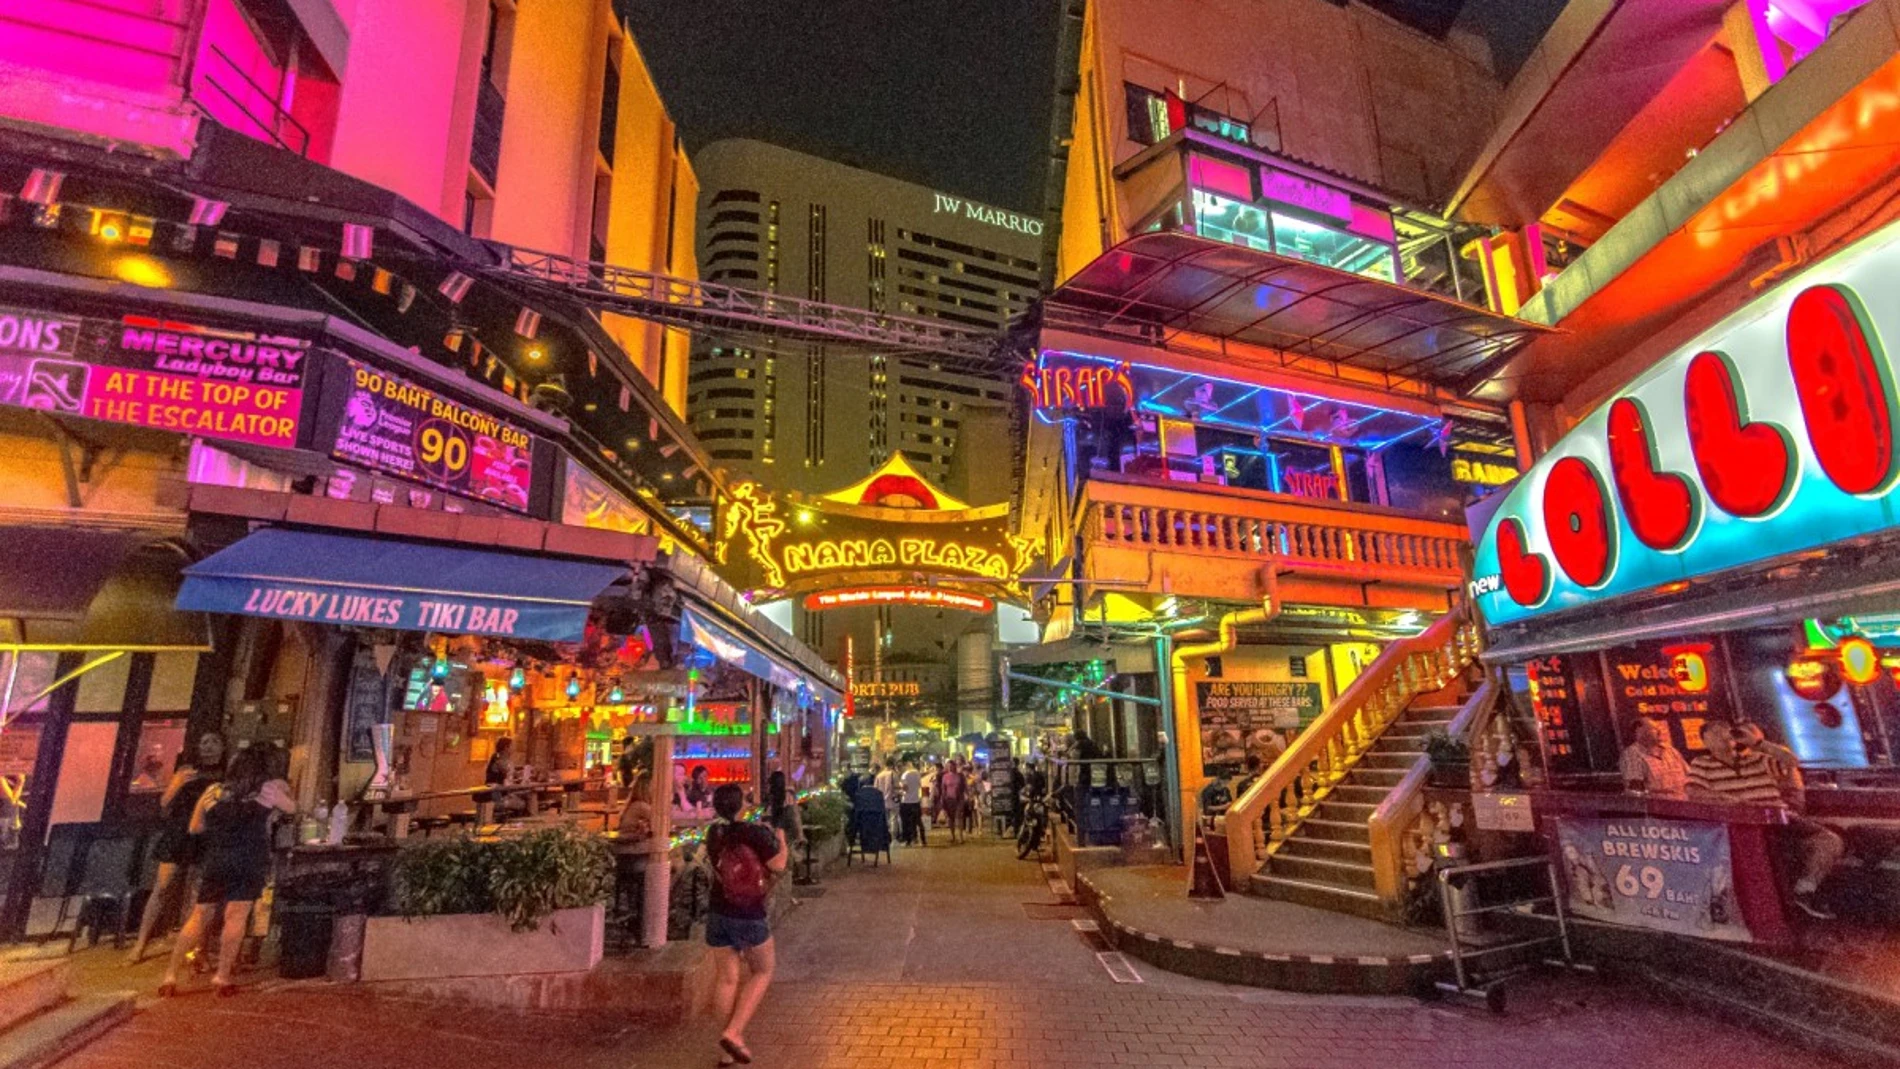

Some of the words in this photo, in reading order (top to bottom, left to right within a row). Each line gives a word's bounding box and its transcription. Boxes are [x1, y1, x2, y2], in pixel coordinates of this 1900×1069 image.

[933, 193, 961, 213] JW
[965, 202, 1044, 236] MARRIO
[0, 314, 62, 352] ONS
[122, 327, 305, 370] MERCURY
[155, 354, 254, 383] Ladyboy
[258, 367, 300, 384] Bar
[106, 372, 140, 394] AT
[147, 375, 195, 401] THE
[201, 382, 249, 405] TOP
[255, 389, 288, 410] OF
[1020, 361, 1134, 410] STRAPS
[93, 397, 142, 423] THE
[150, 404, 296, 439] ESCALATOR
[355, 369, 382, 392] 90
[384, 380, 431, 411] BAHT
[432, 399, 501, 438] BALCONY
[501, 426, 529, 450] BAR
[335, 438, 380, 461] SHOWN
[341, 425, 368, 443] LIVE
[369, 434, 413, 456] SPORTS
[421, 428, 467, 471] 90
[784, 539, 896, 573] NANA
[900, 539, 1009, 579] PLAZA
[1468, 574, 1500, 599] new
[244, 588, 328, 618] LUCKY
[326, 594, 405, 625] LUKES
[417, 601, 466, 630] TIKI
[466, 605, 519, 633] BAR
[1617, 662, 1679, 681] Welco
[889, 682, 919, 696] PUB
[1206, 696, 1229, 709] FOOD
[1229, 696, 1258, 709] SERVED
[1269, 695, 1291, 708] THESE
[1210, 683, 1231, 697] ARE
[1232, 683, 1254, 697] YOU
[1254, 683, 1294, 697] HUNGRY
[1606, 824, 1638, 838] ALL
[1640, 826, 1690, 842] LOCAL
[1602, 839, 1701, 865] BREWSKIS
[1615, 864, 1665, 899] 69
